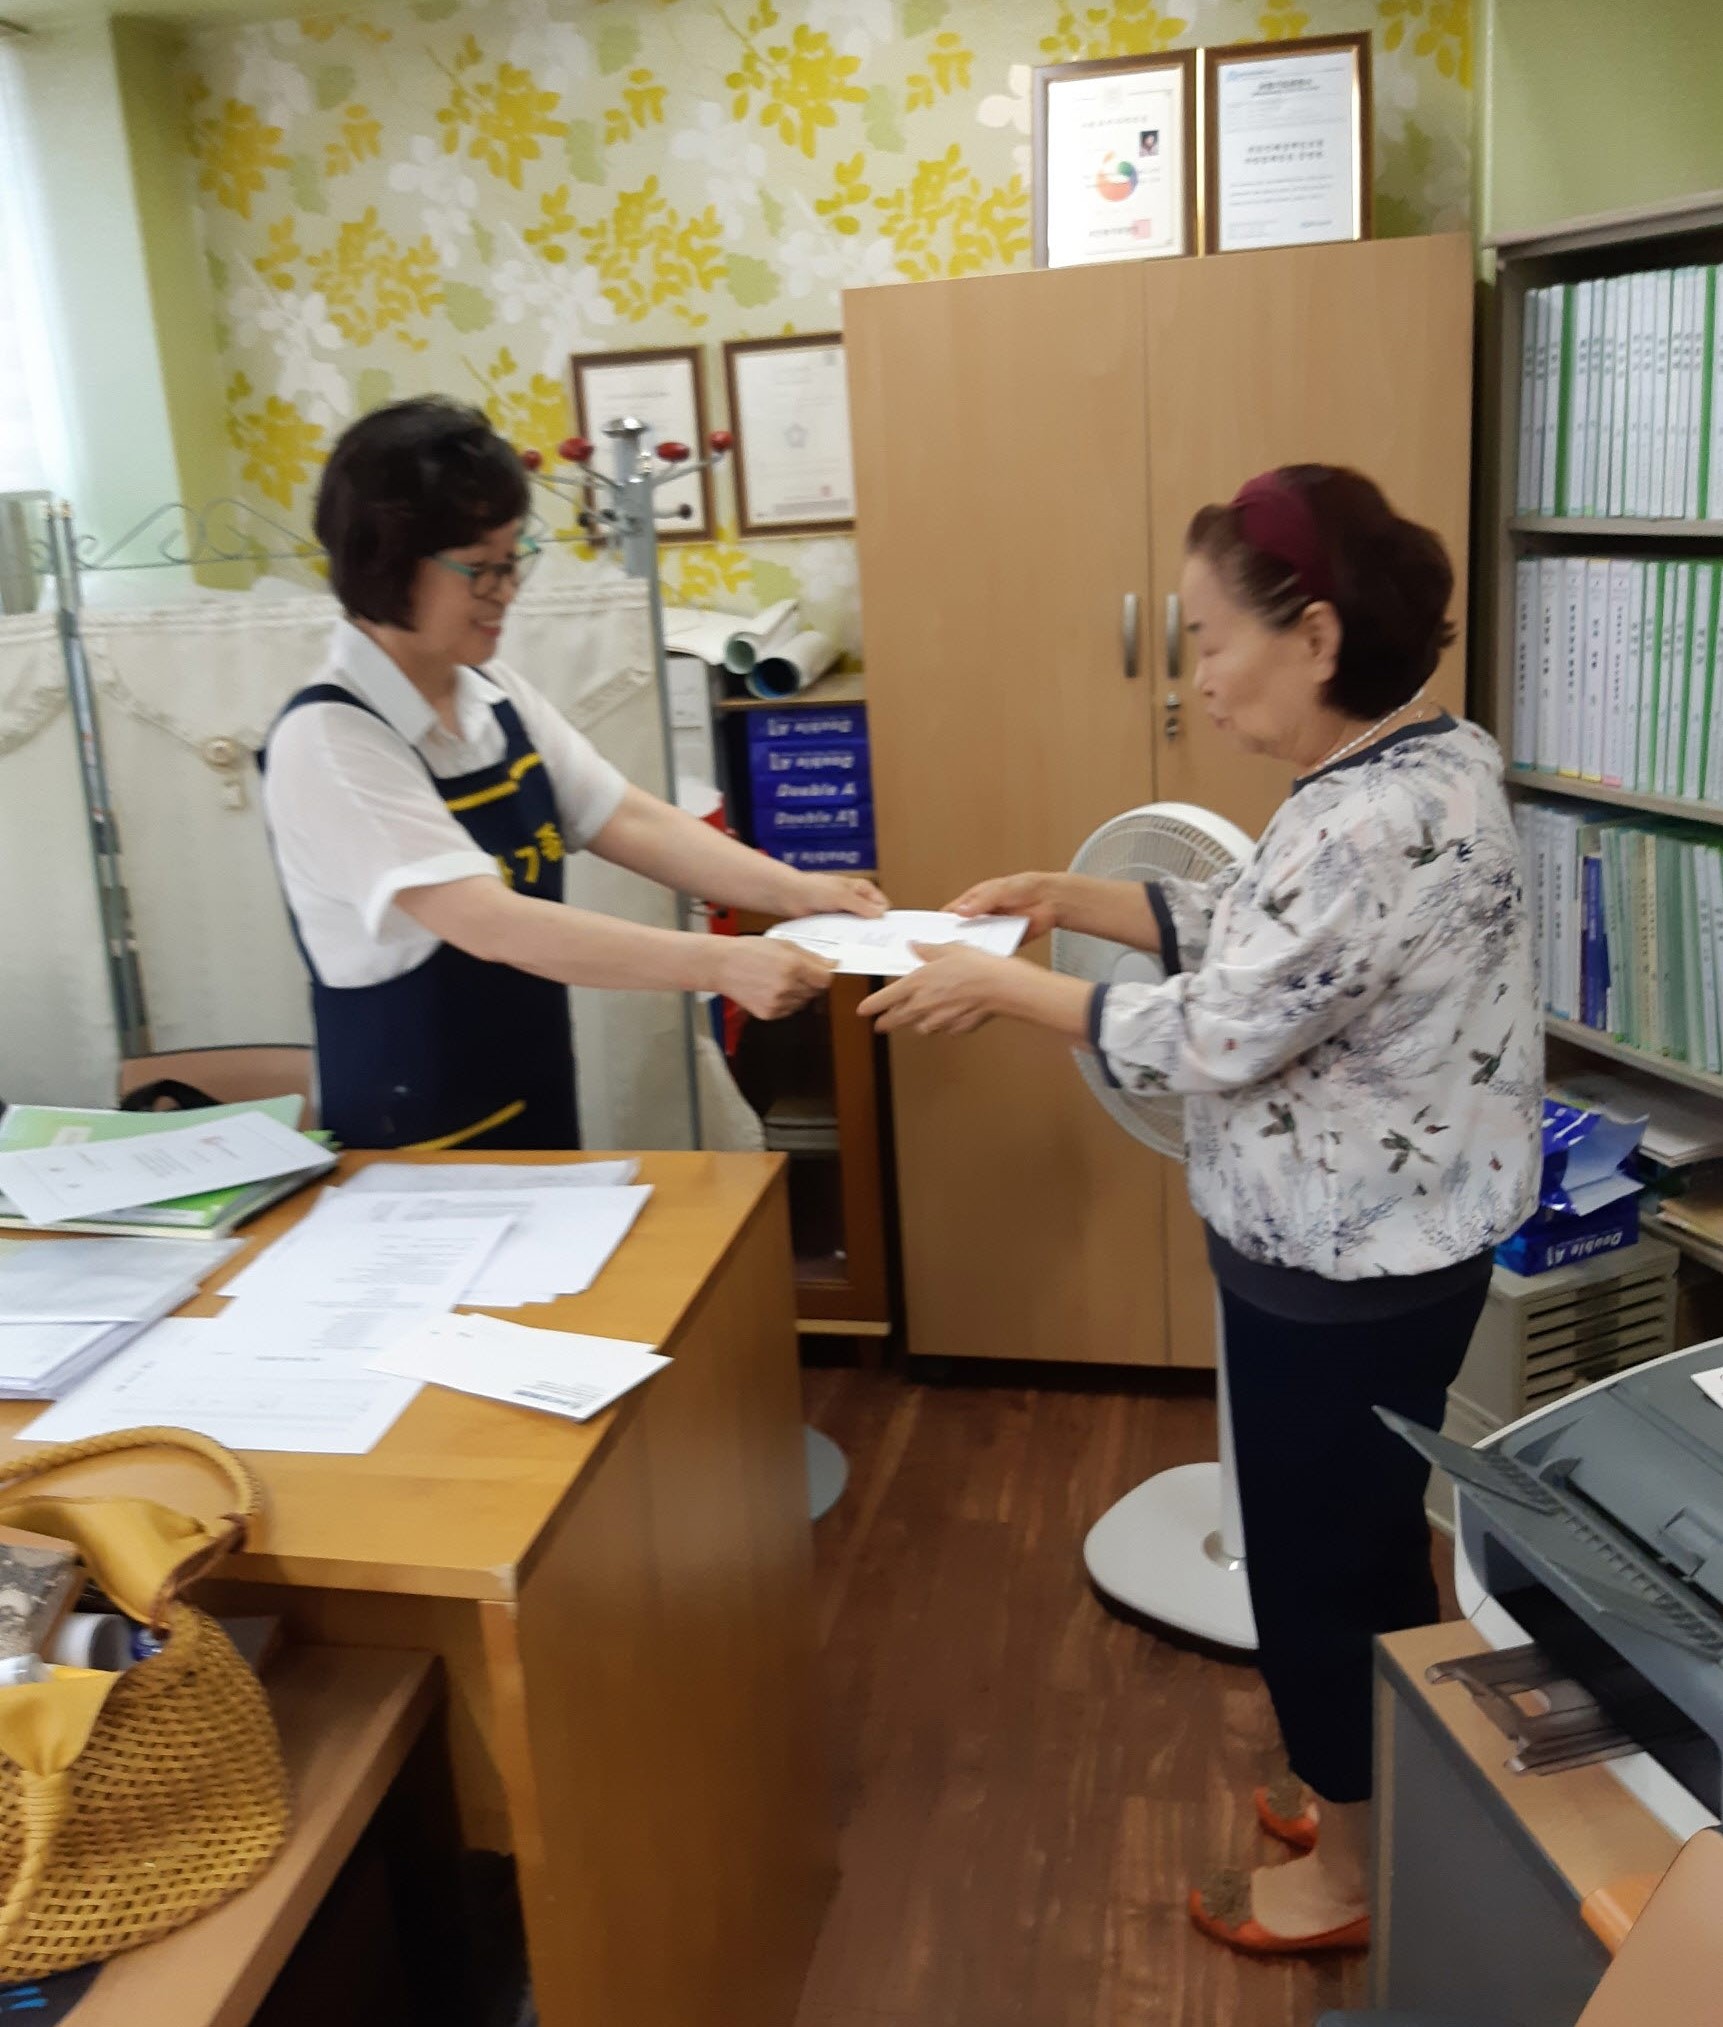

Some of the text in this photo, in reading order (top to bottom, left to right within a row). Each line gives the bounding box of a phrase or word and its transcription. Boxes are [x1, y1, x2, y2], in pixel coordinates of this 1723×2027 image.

[776, 782, 857, 797] Double A
[775, 810, 833, 825] Double
[1570, 1231, 1623, 1256] Double
